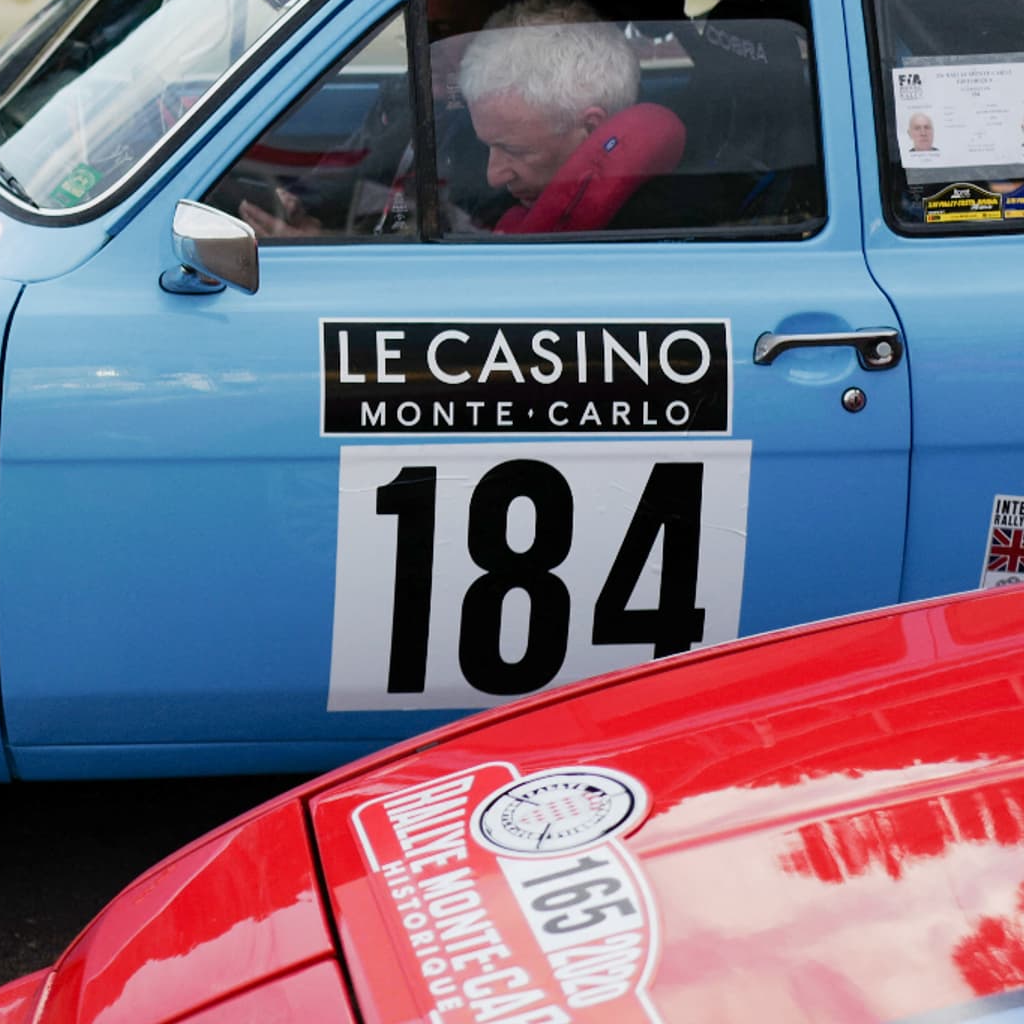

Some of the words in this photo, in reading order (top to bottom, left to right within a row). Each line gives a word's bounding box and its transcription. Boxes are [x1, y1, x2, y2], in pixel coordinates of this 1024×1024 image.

[707, 26, 768, 64] COBRA
[338, 330, 406, 384] LE
[427, 329, 710, 385] CASINO
[376, 459, 705, 695] 184
[383, 775, 476, 874] RALLYE
[522, 857, 638, 935] 165
[382, 860, 465, 1013] HISTORIQUE
[547, 932, 640, 1009] 2020
